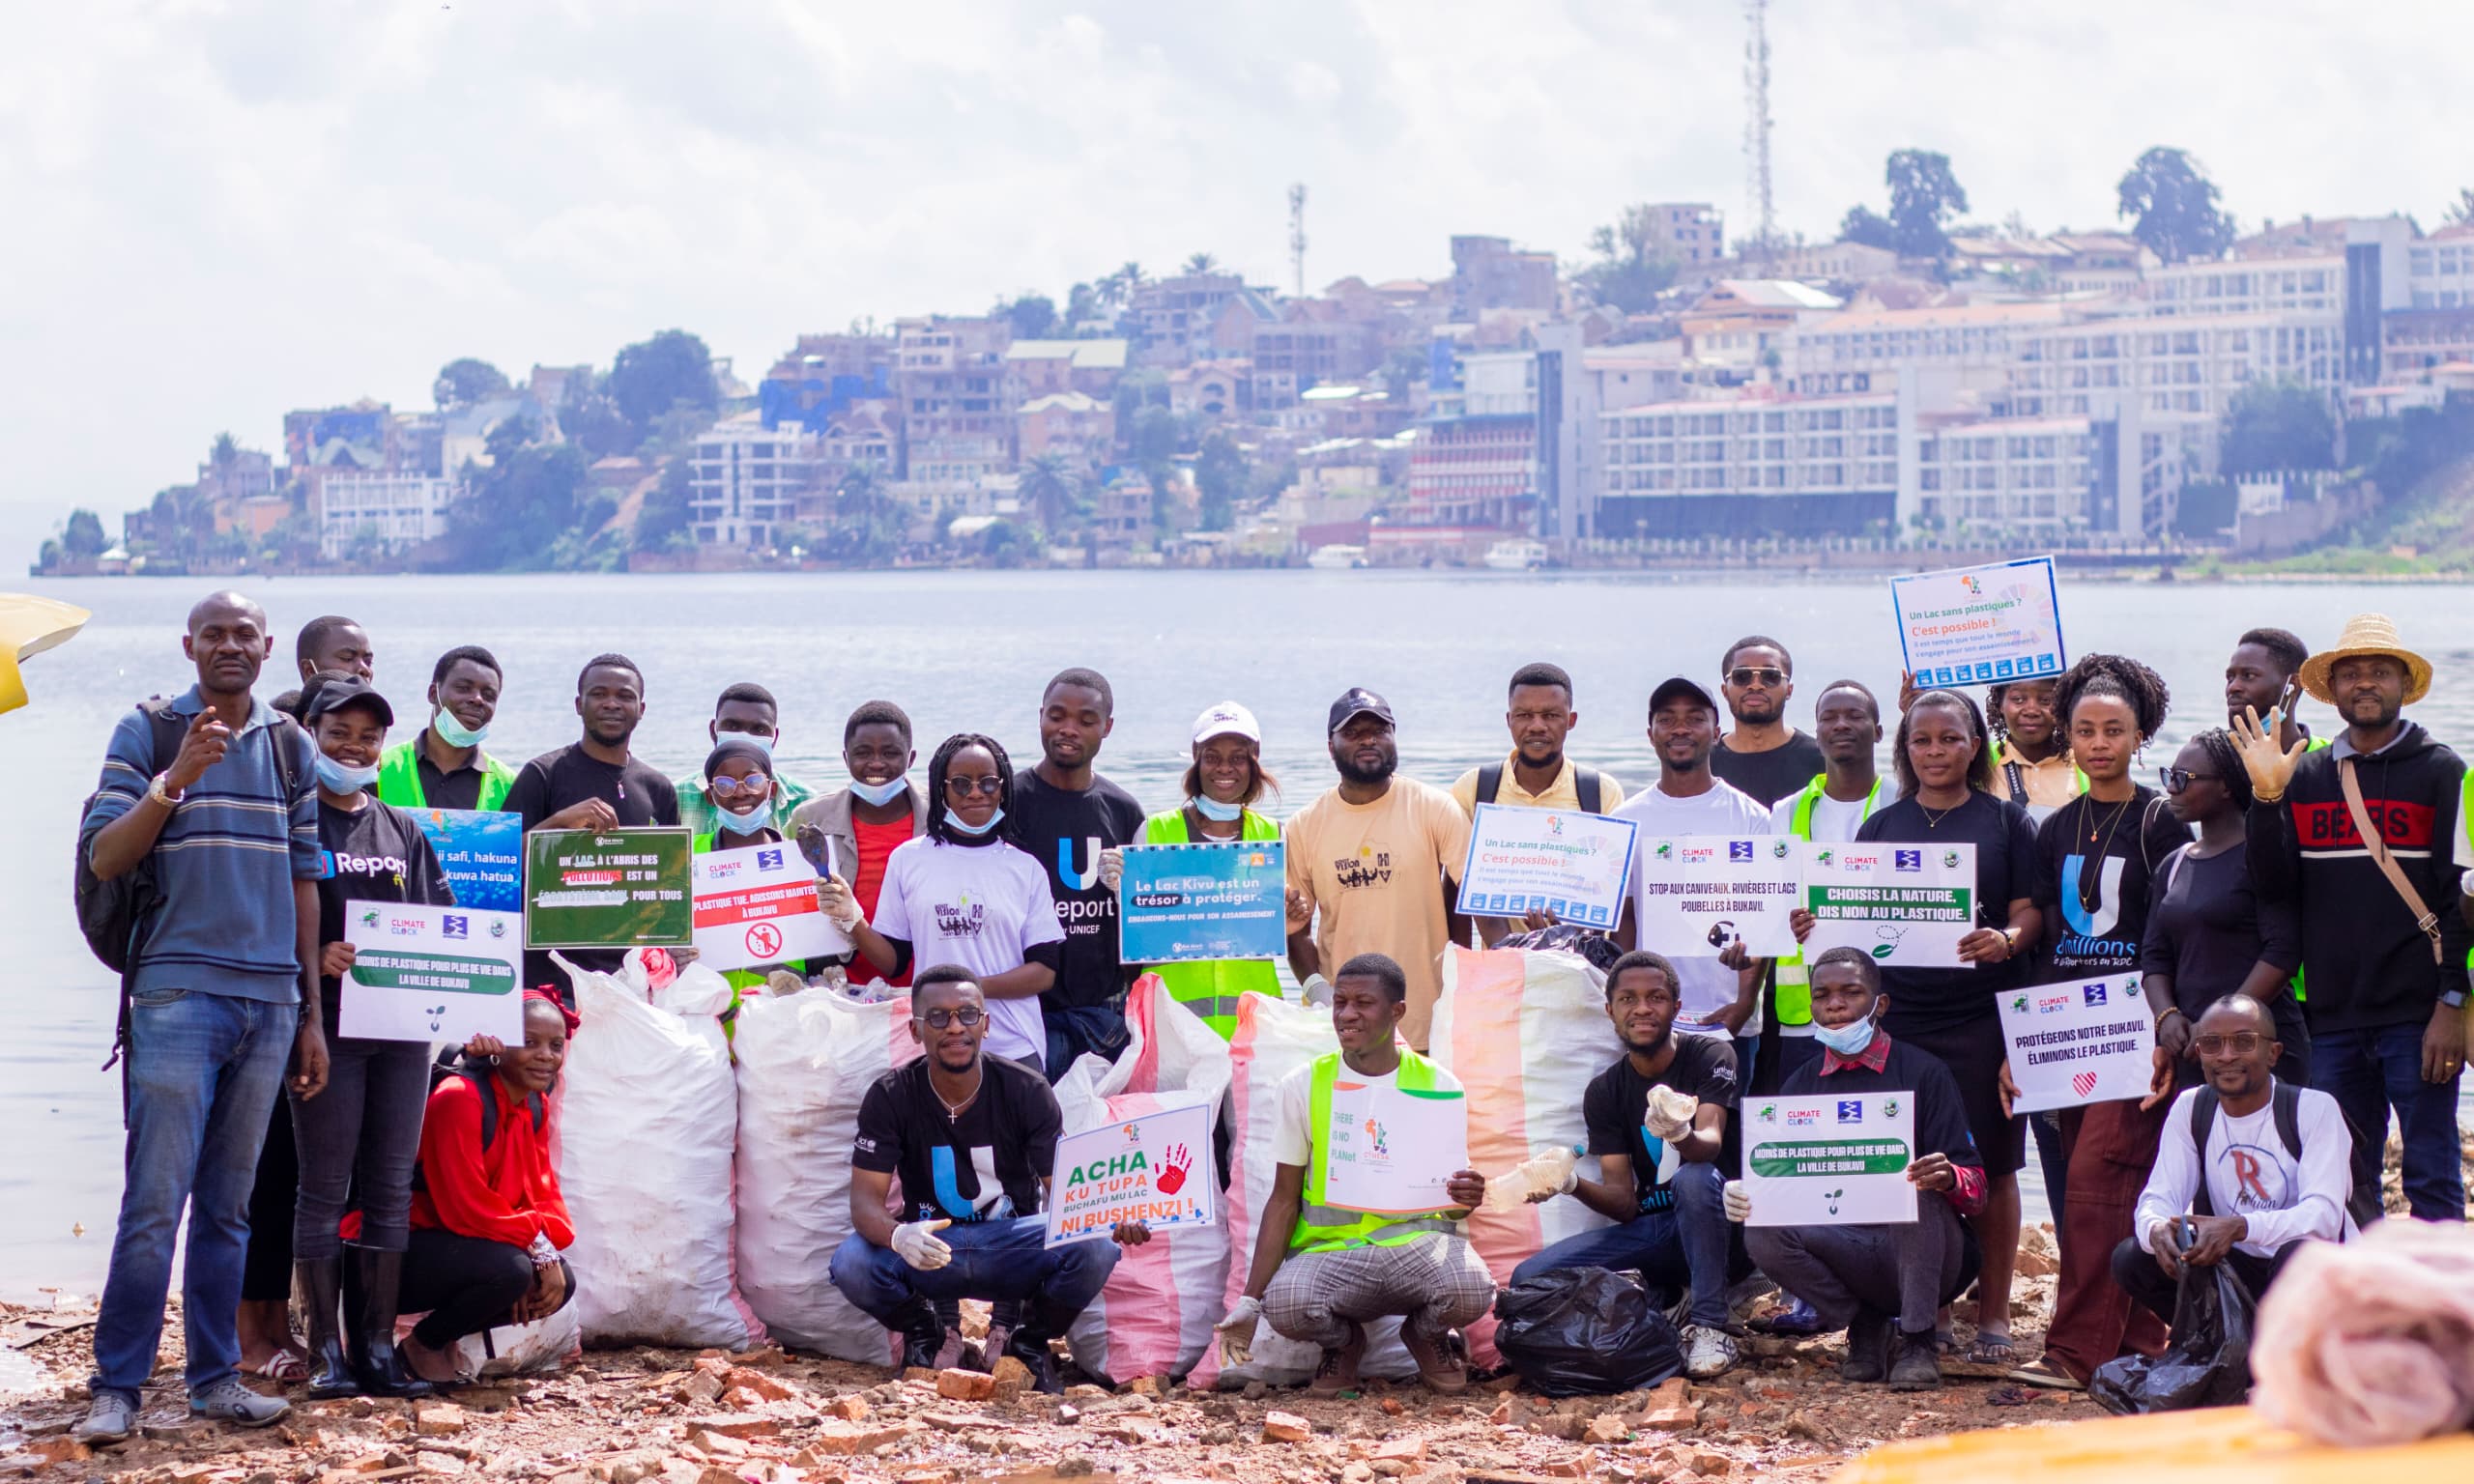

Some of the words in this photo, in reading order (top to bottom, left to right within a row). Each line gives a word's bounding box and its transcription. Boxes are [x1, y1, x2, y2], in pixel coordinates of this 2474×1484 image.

[1909, 612, 1922, 620] Un
[1924, 610, 1940, 618] Lac
[1942, 607, 1963, 616] sans
[1966, 599, 2014, 615] plastiques
[1912, 625, 1939, 637] C'est
[1942, 618, 1989, 635] possible
[1484, 839, 1498, 847] Un
[1500, 840, 1516, 848] Lac
[1517, 842, 1539, 850] sans
[1539, 842, 1590, 856] plastiques
[1592, 848, 1597, 857] ?
[447, 850, 472, 864] safi,
[475, 851, 518, 864] hakuna
[559, 856, 572, 867] UN
[597, 854, 604, 866] À
[606, 855, 639, 866] L'ABRIS
[642, 855, 658, 865] DES
[1482, 853, 1509, 864] C'est
[1511, 854, 1559, 867] possible
[709, 862, 741, 872] CLIMATE
[444, 869, 477, 881] kuwa
[480, 870, 514, 882] hatua
[562, 870, 622, 882] POLLUTIONS
[626, 870, 643, 881] EST
[645, 870, 657, 881] UN
[1136, 880, 1152, 892] Le
[1155, 879, 1179, 892] Lac
[1183, 877, 1214, 890] Kivu
[1218, 878, 1239, 889] est
[1243, 878, 1260, 888] un
[1649, 883, 1669, 895] STOP
[1669, 883, 1684, 895] AUX
[1732, 880, 1767, 895] RIVIÈRES
[1768, 883, 1776, 895] ET
[1777, 883, 1797, 895] LACS
[633, 891, 656, 900] POUR
[659, 890, 682, 900] TOUS
[693, 898, 733, 912] PLASTIQUE
[750, 890, 785, 903] AGISSONS
[1136, 895, 1179, 906] trésor
[1182, 895, 1192, 905] à
[1195, 892, 1262, 907] protéger.
[1827, 888, 1881, 901] CHOISIS
[1883, 889, 1899, 901] LA
[2061, 854, 2126, 937] U
[742, 906, 749, 919] À
[748, 904, 778, 917] BUKAVU
[1682, 900, 1725, 912] POUBELLES
[1726, 899, 1733, 912] À
[1733, 900, 1765, 912] BUKAVU.
[1818, 905, 1840, 918] DIS
[1842, 906, 1869, 918] NON
[1871, 906, 1889, 919] AU
[1891, 907, 1967, 922] PLASTIQUE.
[391, 919, 425, 928] CLIMATE
[1069, 925, 1101, 934] UNICEF
[356, 956, 380, 967] MOINS
[381, 956, 391, 968] DE
[390, 957, 431, 971] PLASTIQUE
[431, 959, 450, 972] POUR
[451, 961, 470, 974] PLUS
[470, 963, 480, 974] DE
[480, 964, 493, 976] VIE
[492, 965, 511, 977] DANS
[399, 974, 409, 985] LA
[409, 975, 431, 986] VILLE
[431, 976, 441, 986] DE
[441, 977, 470, 989] BUKAVU
[2039, 996, 2069, 1007] CLIMATE
[2016, 1029, 2077, 1048] PROTÉGEONS
[2078, 1026, 2107, 1042] NOTRE
[2028, 1048, 2076, 1066] ÉLIMINONS
[2078, 1046, 2088, 1058] LE
[1334, 1111, 1354, 1125] THERE
[1754, 1149, 1778, 1158] MOINS
[1778, 1148, 1788, 1158] DE
[1789, 1146, 1827, 1158] PLASTIQUE
[1827, 1146, 1846, 1156] POUR
[1847, 1145, 1865, 1156] PLUS
[1865, 1145, 1875, 1156] DE
[1875, 1144, 1886, 1156] VIE
[1886, 1144, 1905, 1155] DANS
[1067, 1151, 1148, 1187] ACHA
[1797, 1162, 1806, 1173] LA
[1807, 1161, 1827, 1172] VILLE
[1827, 1161, 1837, 1172] DE
[1837, 1160, 1865, 1171] BUKAVU
[2230, 1150, 2271, 1200] R
[1065, 1186, 1090, 1203] KU
[1098, 1174, 1147, 1195] TUPA
[1063, 1196, 1108, 1213] BUCHAFU
[1110, 1192, 1127, 1202] MU
[1128, 1189, 1148, 1199] LAC
[1060, 1215, 1080, 1234] NI
[1083, 1199, 1182, 1228] BUSHENZI
[1187, 1197, 1194, 1214] !
